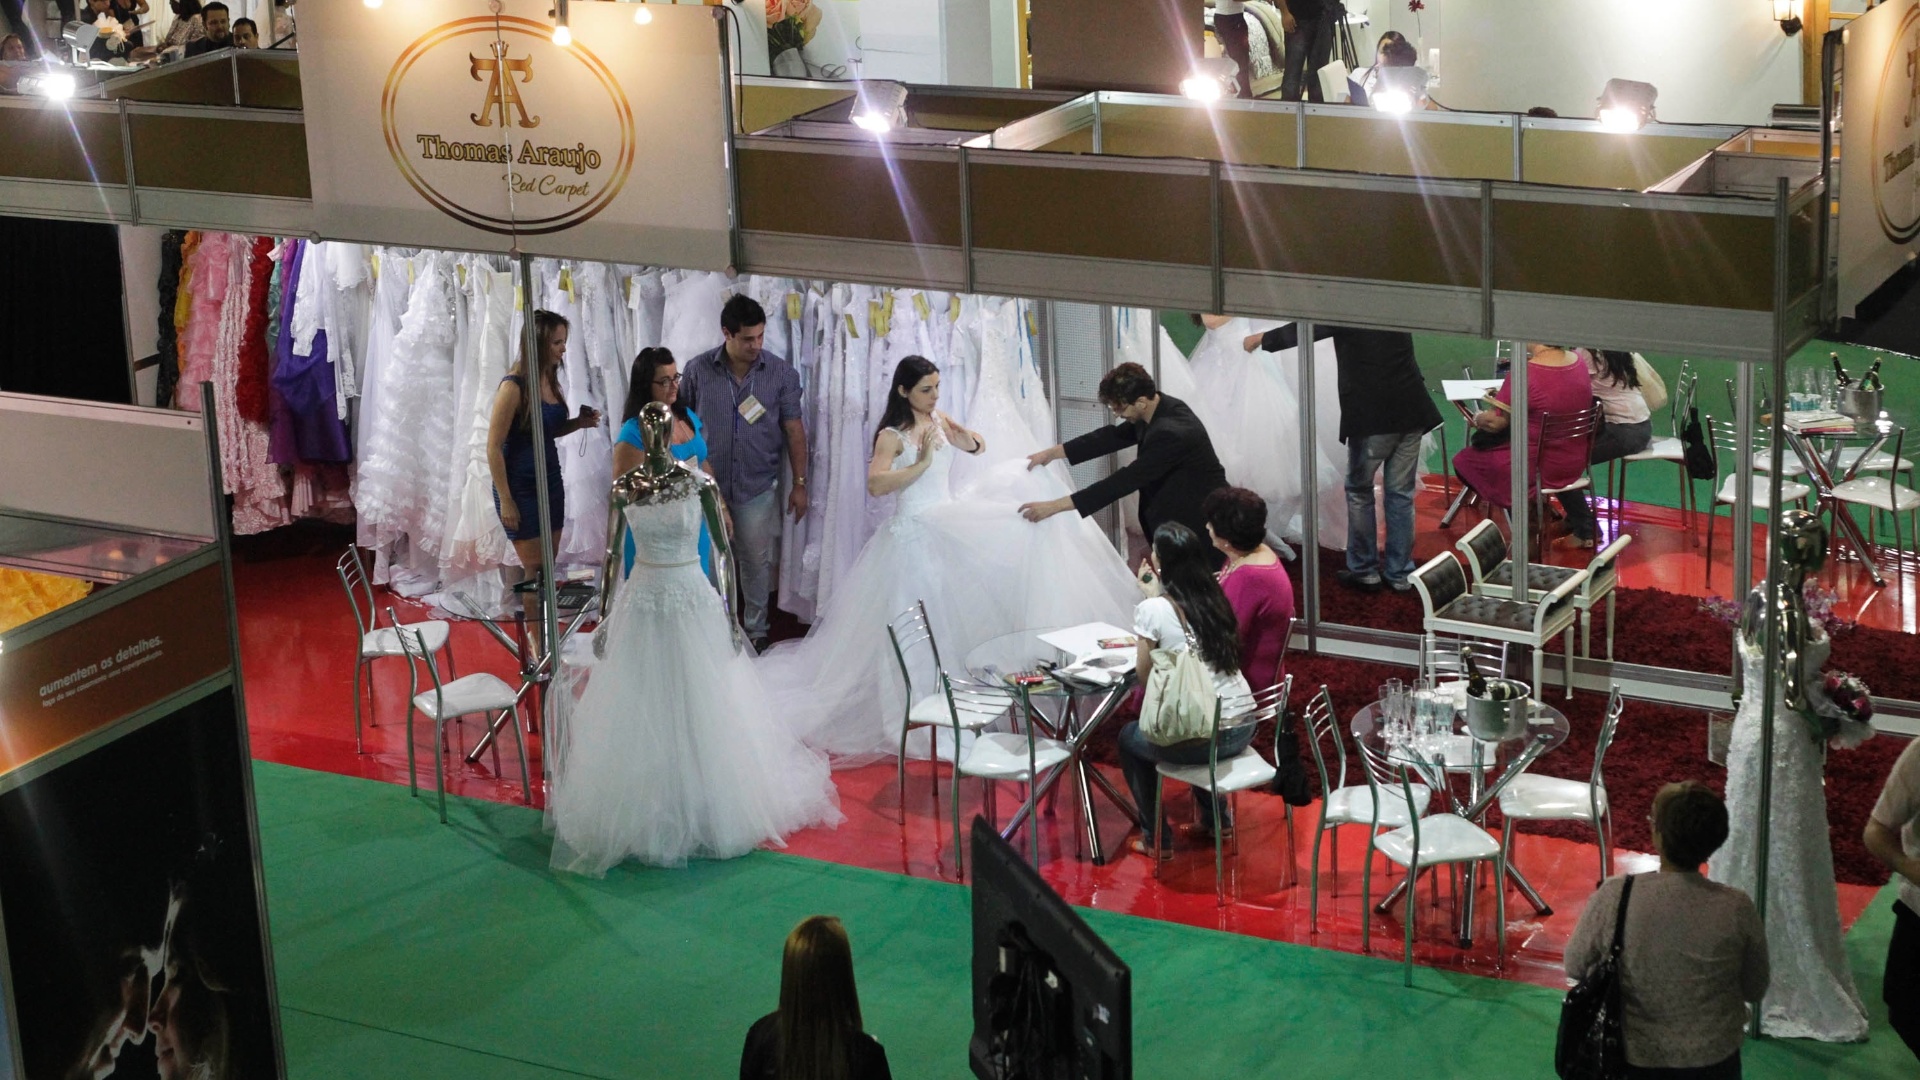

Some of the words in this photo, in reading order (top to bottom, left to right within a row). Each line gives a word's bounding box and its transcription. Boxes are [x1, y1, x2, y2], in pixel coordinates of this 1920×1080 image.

[417, 134, 513, 163] Thomas
[518, 139, 601, 175] Araujo
[502, 172, 536, 193] Red
[538, 175, 589, 201] Carpet
[39, 664, 98, 697] aumentem
[101, 656, 113, 670] os
